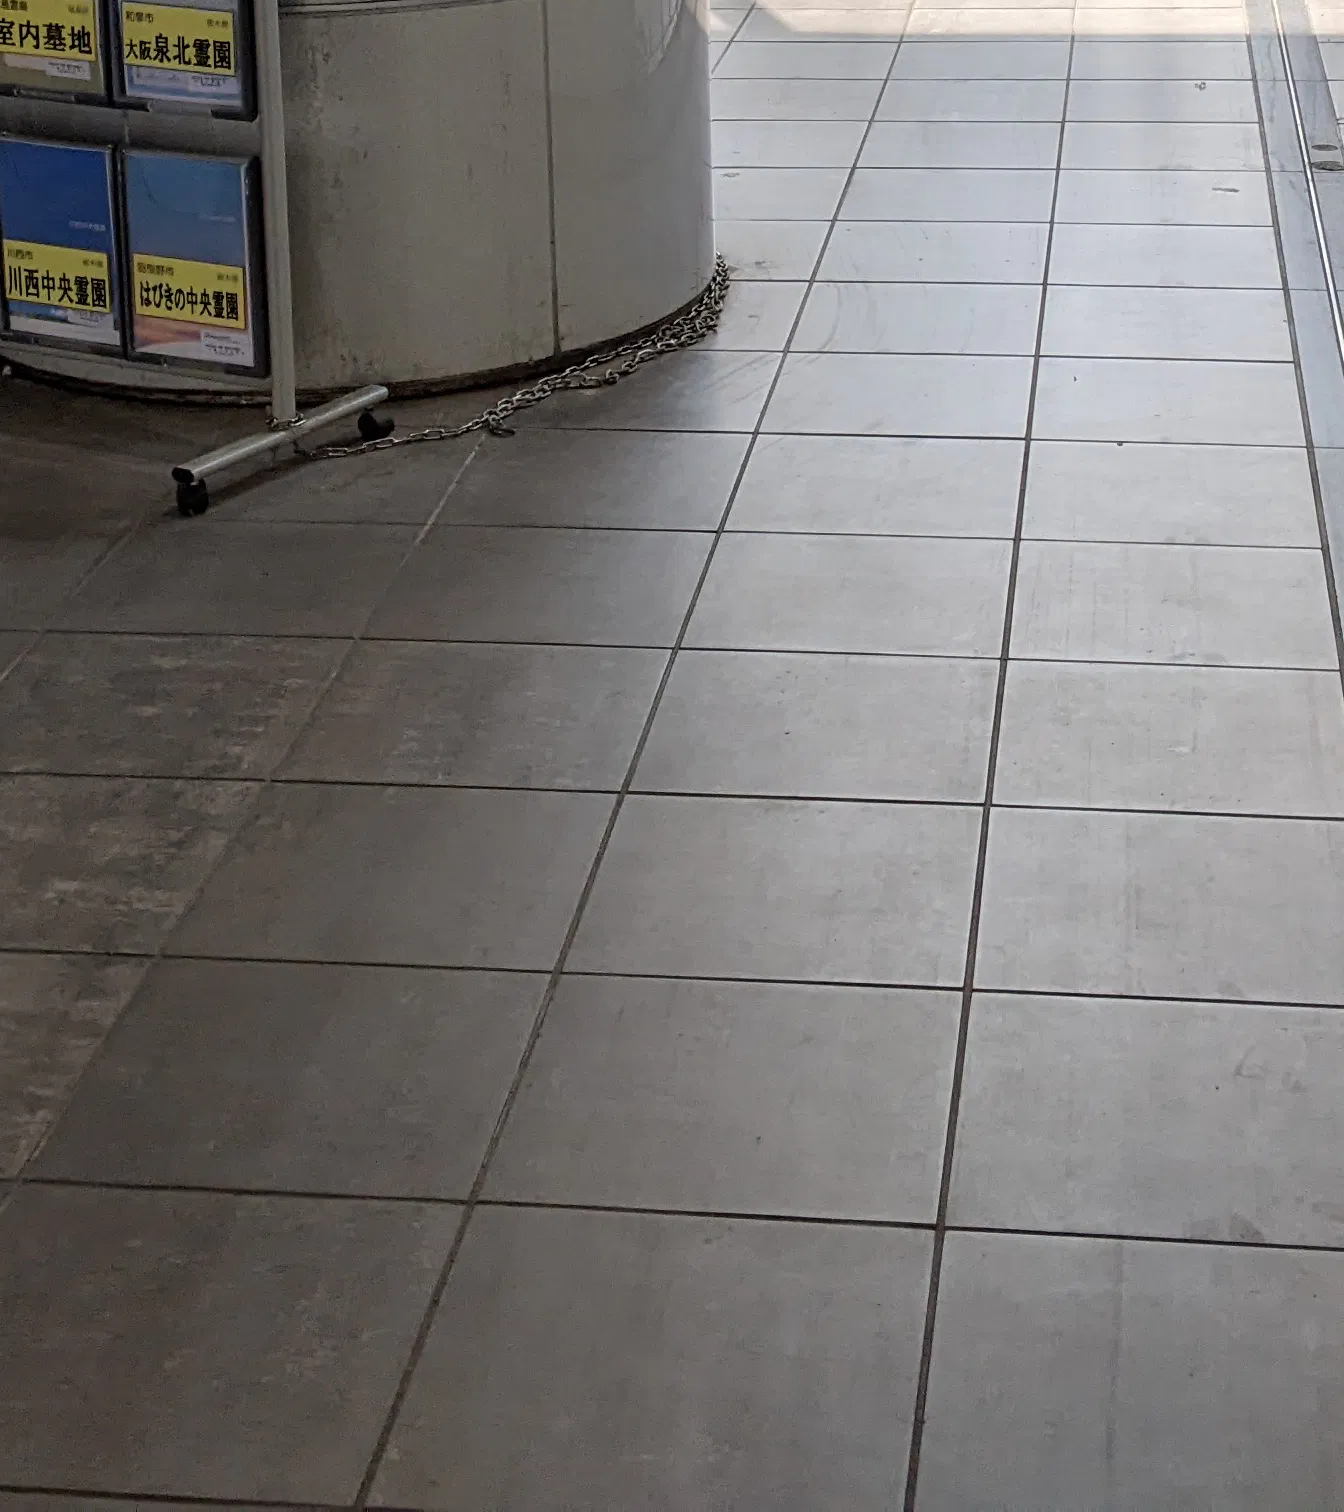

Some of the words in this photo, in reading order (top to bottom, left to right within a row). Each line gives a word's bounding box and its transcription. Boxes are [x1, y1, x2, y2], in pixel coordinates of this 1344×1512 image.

[125, 32, 232, 71] 大阪泉北霊園
[7, 265, 107, 309] 川西中央霊園
[139, 280, 239, 322] はびきの中央霊園
